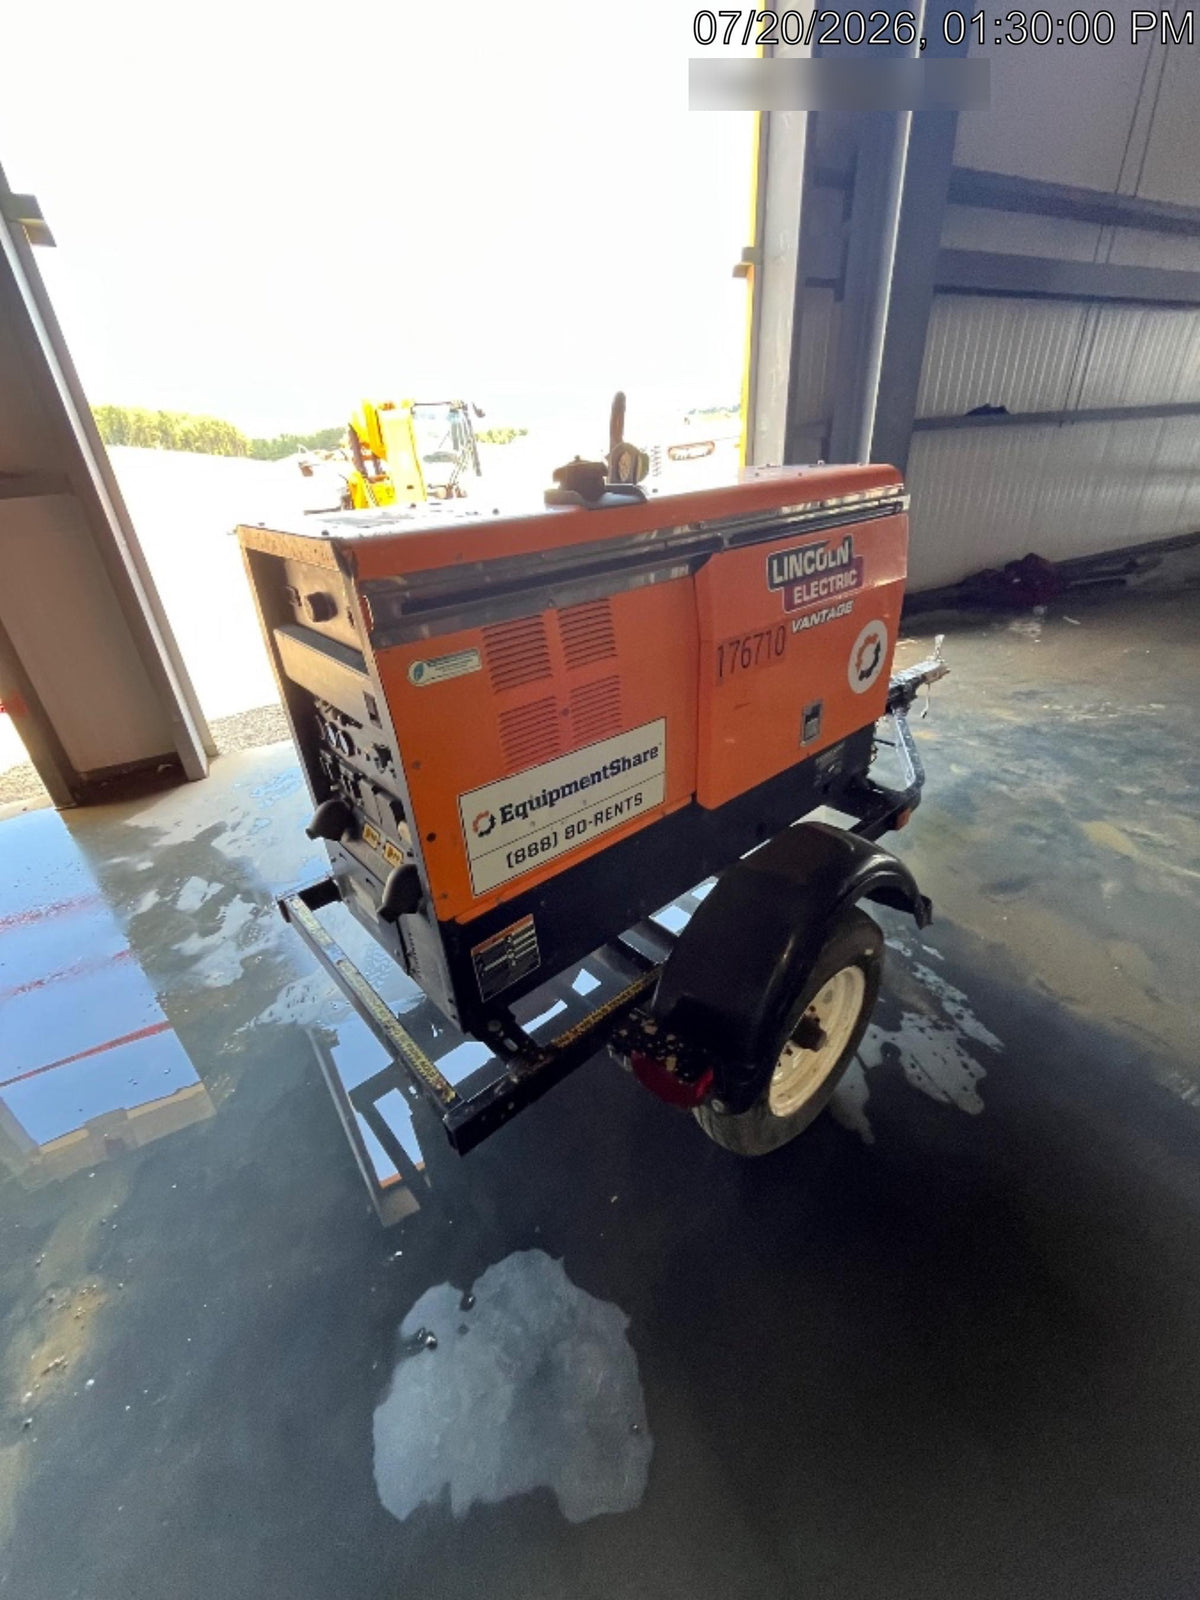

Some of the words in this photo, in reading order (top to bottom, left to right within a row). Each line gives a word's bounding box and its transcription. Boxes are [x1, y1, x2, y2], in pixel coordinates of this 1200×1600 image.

[772, 540, 850, 584] LINCOLN
[793, 569, 858, 604] ELECTRIC
[791, 600, 854, 634] VANTAGE
[716, 625, 787, 678] 176710
[499, 745, 660, 826] EquipmentShare
[505, 831, 559, 869] (888)
[564, 792, 644, 841] 80-RENTS
